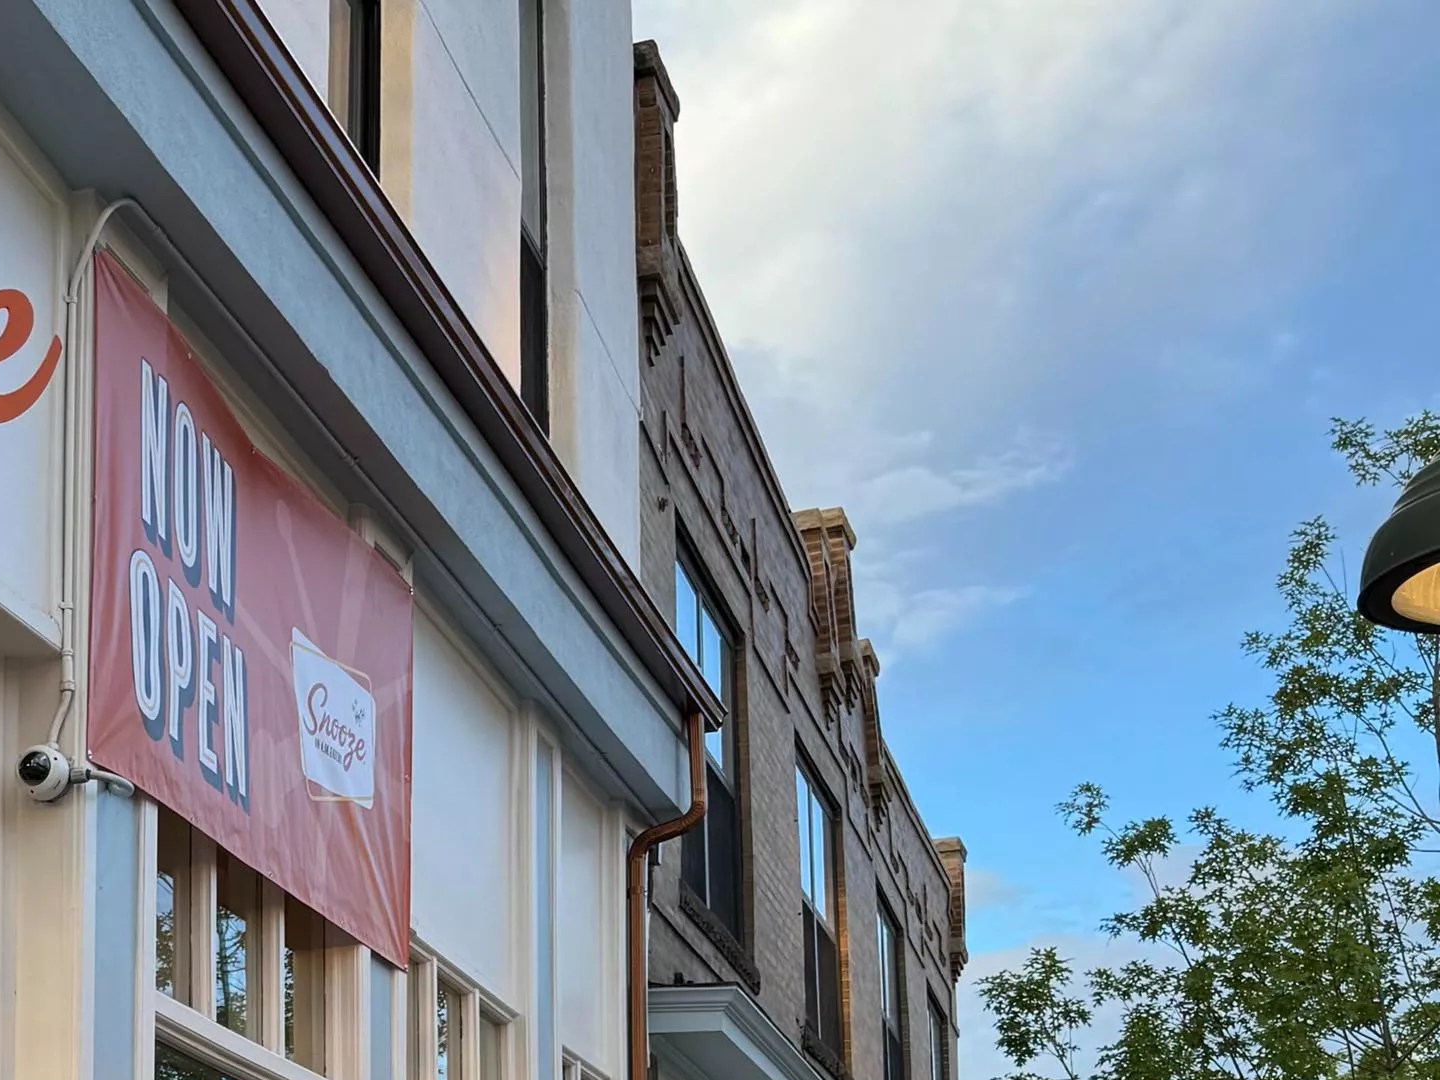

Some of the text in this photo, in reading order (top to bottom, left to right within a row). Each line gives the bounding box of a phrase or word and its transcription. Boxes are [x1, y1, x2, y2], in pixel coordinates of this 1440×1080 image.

[140, 356, 237, 623] NOW
[128, 547, 249, 816] OPEN
[303, 682, 366, 773] Snooze
